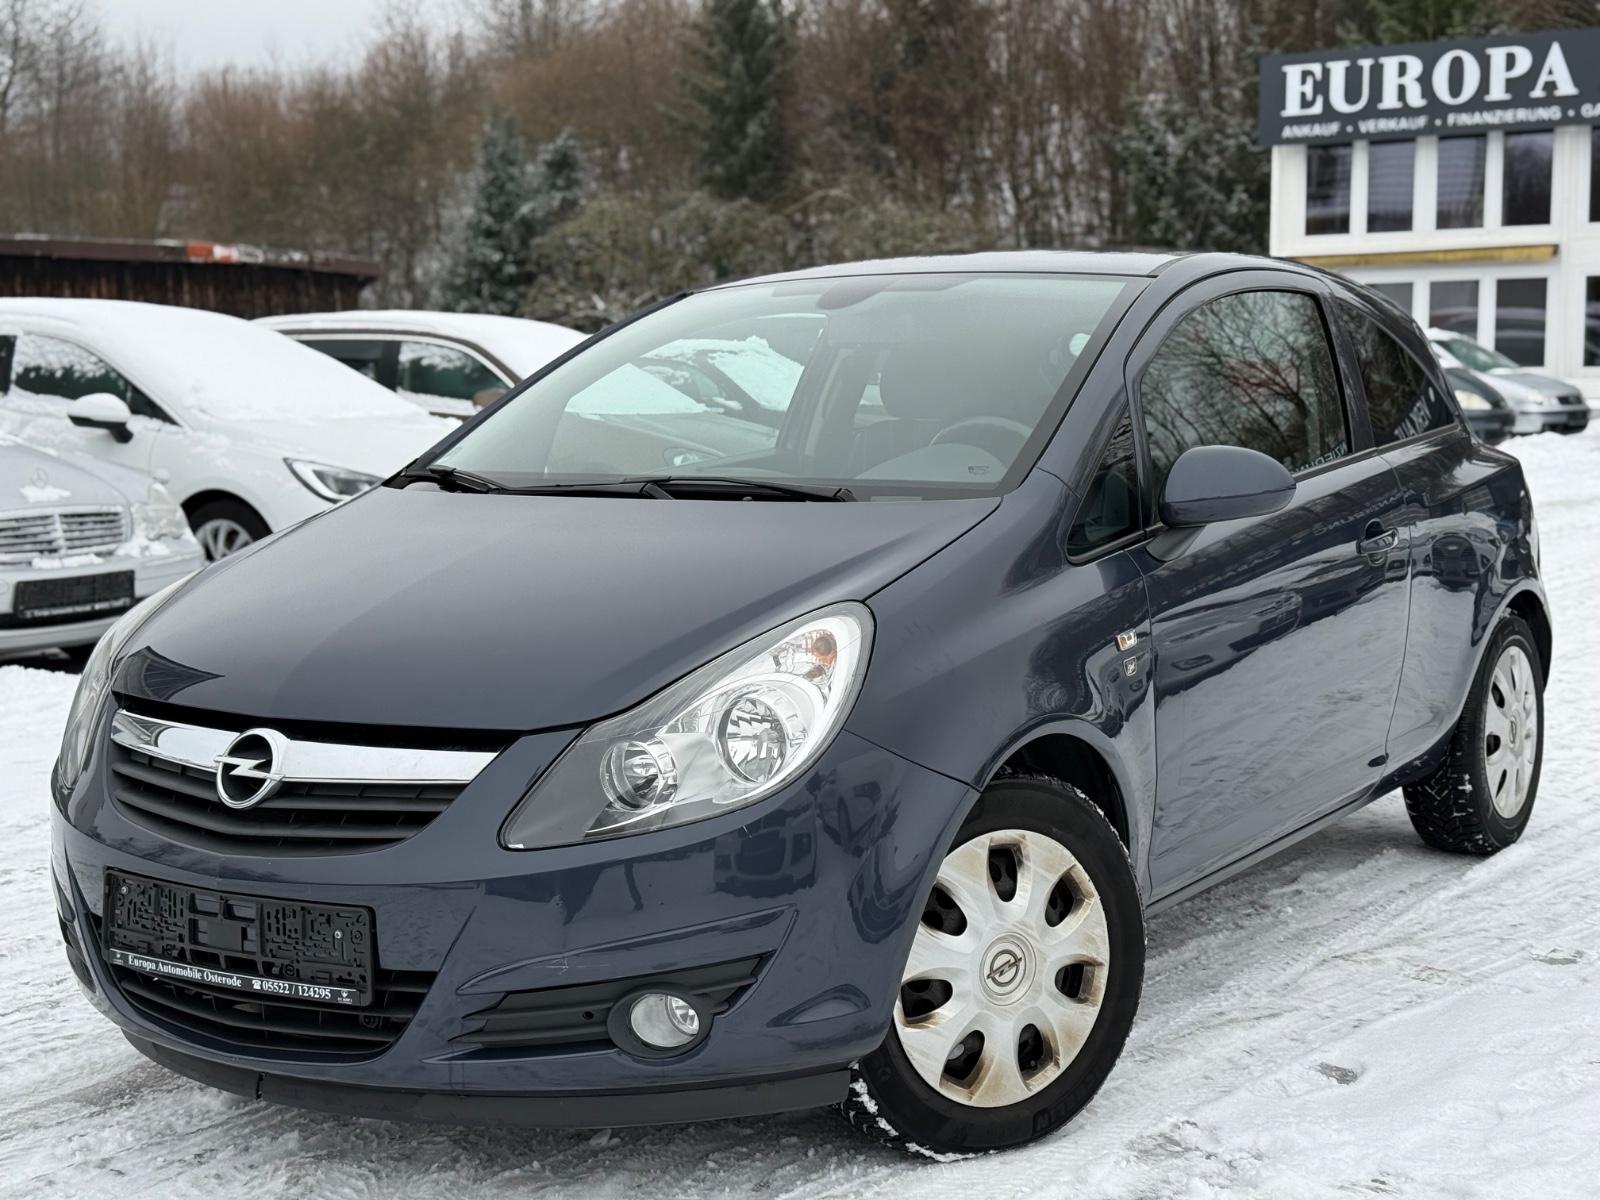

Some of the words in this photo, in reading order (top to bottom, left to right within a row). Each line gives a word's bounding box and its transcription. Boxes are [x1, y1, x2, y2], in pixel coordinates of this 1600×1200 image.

[1281, 41, 1579, 117] EUROPA
[1281, 121, 1341, 139] ANKAUF
[1358, 115, 1428, 134] VERKAUF
[1447, 105, 1562, 127] FINANZIERUNG
[128, 954, 156, 971] Europa
[157, 961, 202, 980] Automobile
[203, 970, 242, 987] Osterode
[262, 981, 290, 994] 05522
[298, 985, 331, 999] 124295
